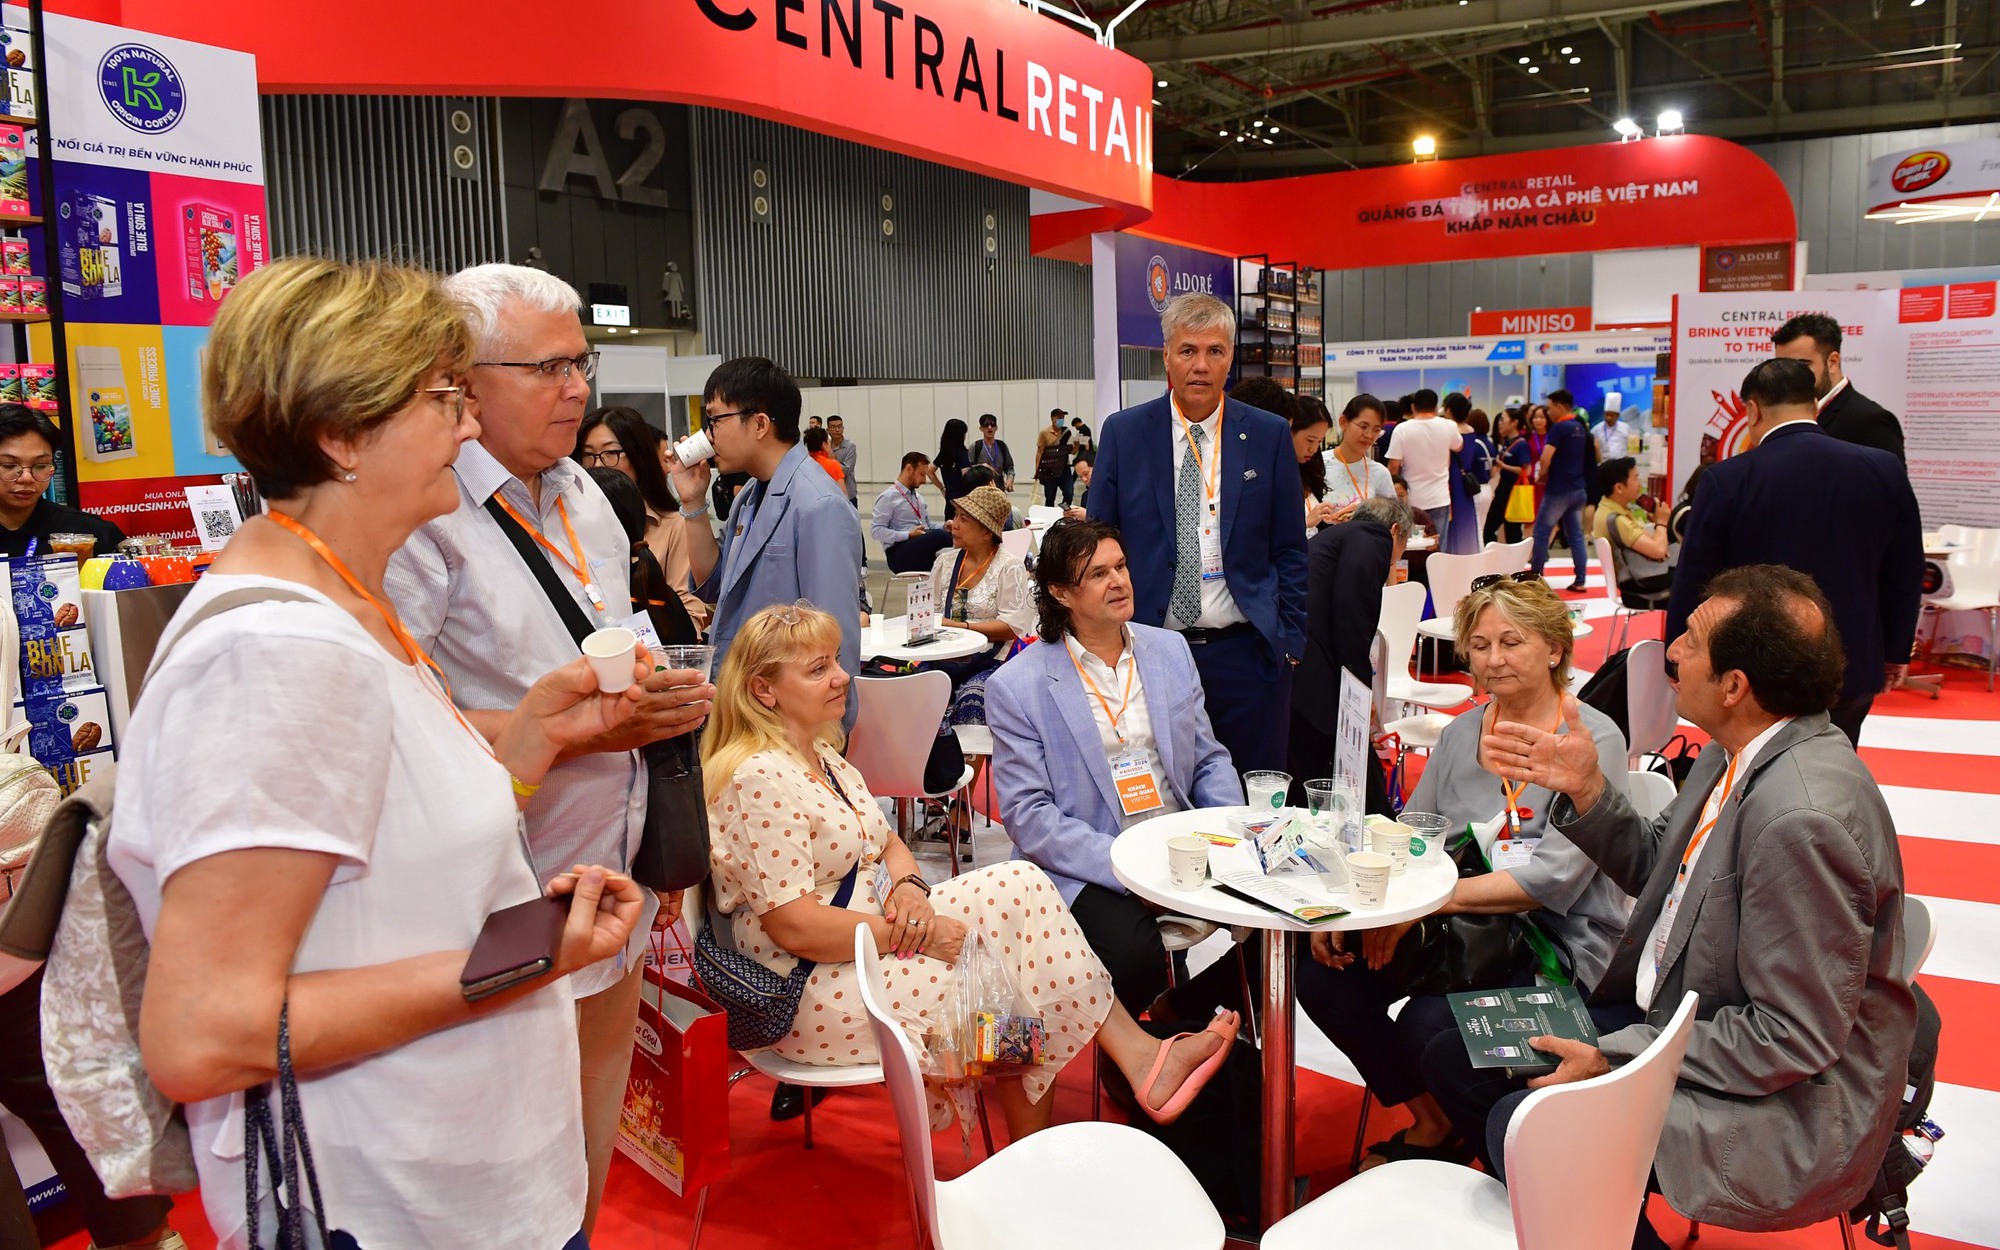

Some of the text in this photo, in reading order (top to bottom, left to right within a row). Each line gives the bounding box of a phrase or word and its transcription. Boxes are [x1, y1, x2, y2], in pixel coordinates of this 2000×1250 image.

[106, 50, 175, 82] 100% NATURAL
[111, 99, 177, 129] ORIGIN COFFEE
[83, 142, 104, 154] GIÁ
[107, 146, 125, 158] TRỊ
[189, 157, 220, 169] HẠNH
[223, 161, 253, 173] PHÚC
[539, 98, 668, 208] A2
[1422, 200, 1443, 218] BÁ
[1493, 193, 1531, 212] HOA
[1536, 189, 1562, 208] CÀ
[1566, 184, 1602, 206] PHÊ
[1607, 182, 1649, 204] VIỆT
[1653, 180, 1699, 199] NAM
[134, 202, 148, 252] BLUE SON LA
[1543, 208, 1594, 226] CHÂU
[251, 226, 261, 239] SON
[251, 242, 263, 260] BLUE
[1174, 272, 1213, 295] ADORÉ
[597, 308, 626, 318] EXIT
[1502, 313, 1575, 333] MINISO
[1688, 327, 1730, 338] BRING
[1724, 342, 1773, 352] TO THE
[146, 347, 161, 409] HONEY PROCESS
[144, 492, 164, 500] MUA
[26, 635, 71, 661] BLUE
[29, 651, 92, 679] SON LA
[642, 1028, 658, 1048] Cool
